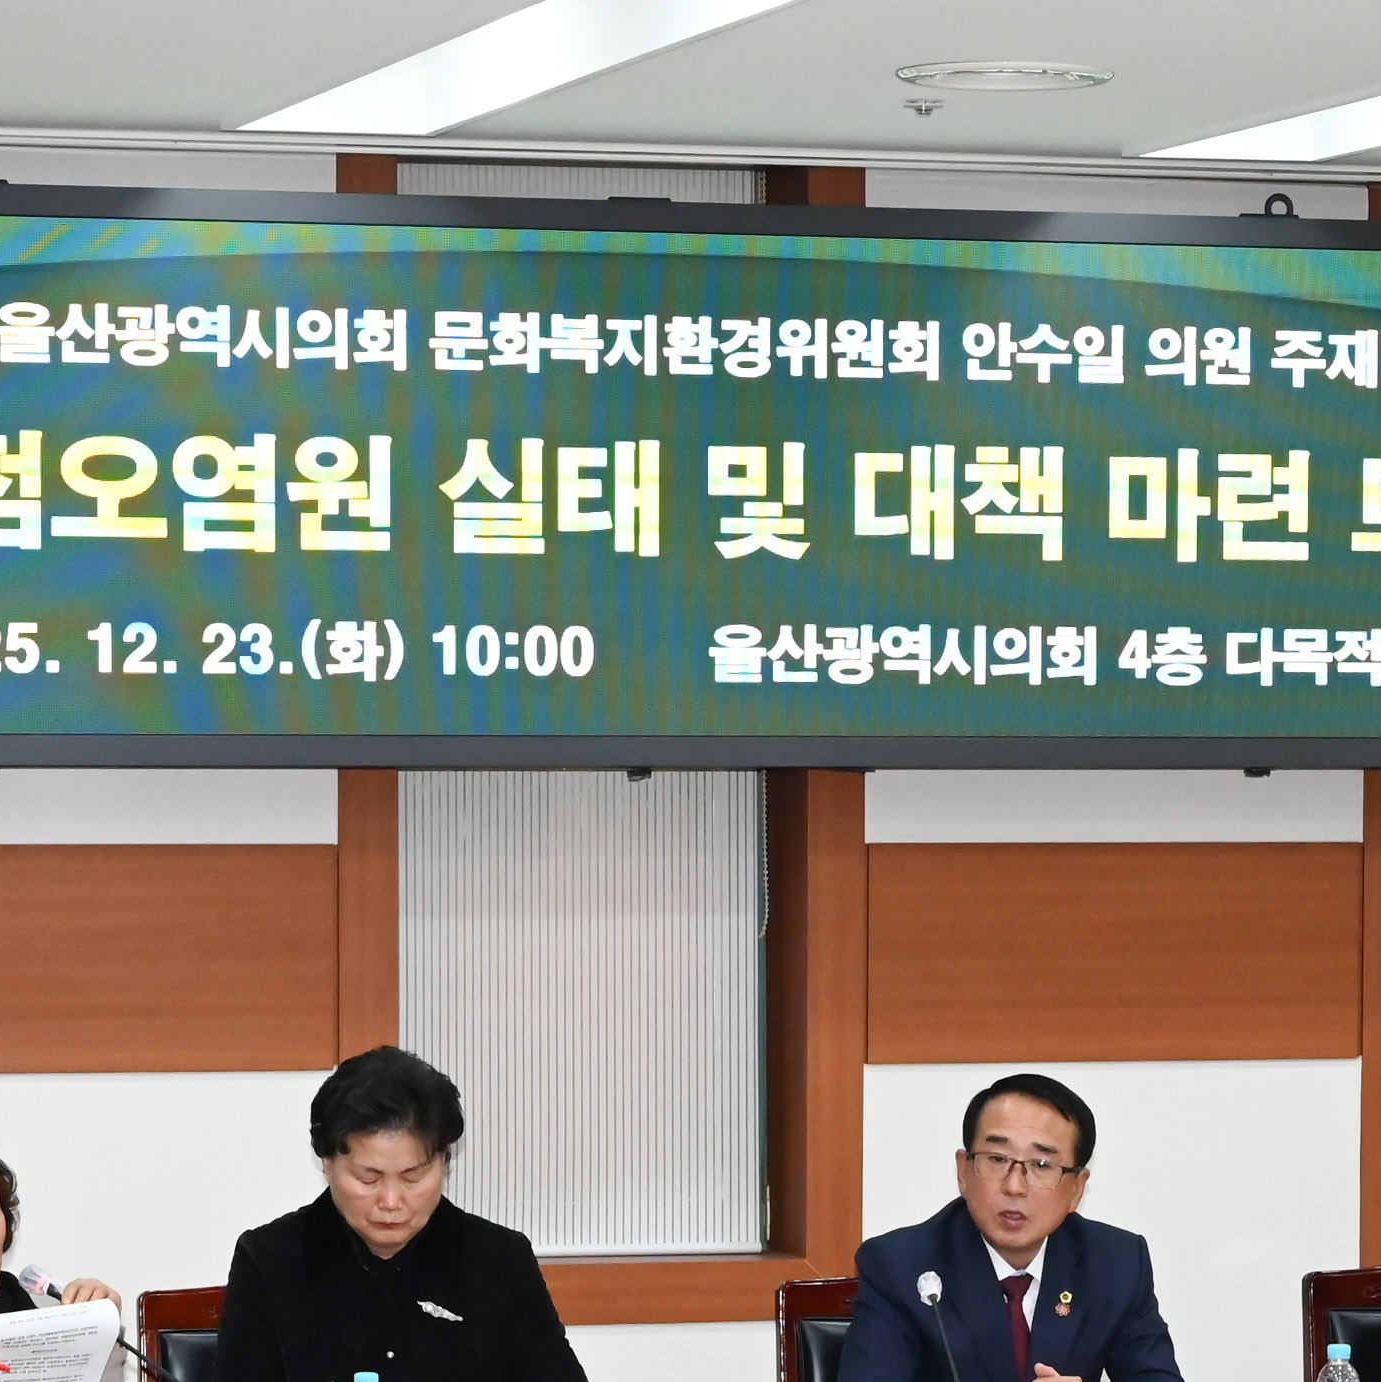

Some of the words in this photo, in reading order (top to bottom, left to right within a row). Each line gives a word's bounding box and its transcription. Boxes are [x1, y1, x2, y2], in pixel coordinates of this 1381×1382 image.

[429, 312, 939, 380] 문화복지환경위원회
[963, 322, 1124, 383] 안수일
[1145, 327, 1251, 385] 의원
[1271, 330, 1378, 388] 주재
[439, 438, 660, 556] 실태
[708, 442, 810, 559] 및
[855, 445, 1063, 561] 대책
[1109, 448, 1310, 562] 마련
[88, 623, 176, 673] 12.
[203, 619, 403, 681] 23.(화)
[433, 625, 594, 676] 10:00
[709, 624, 1096, 685] 울산광역시의회
[1119, 627, 1207, 685] 4층
